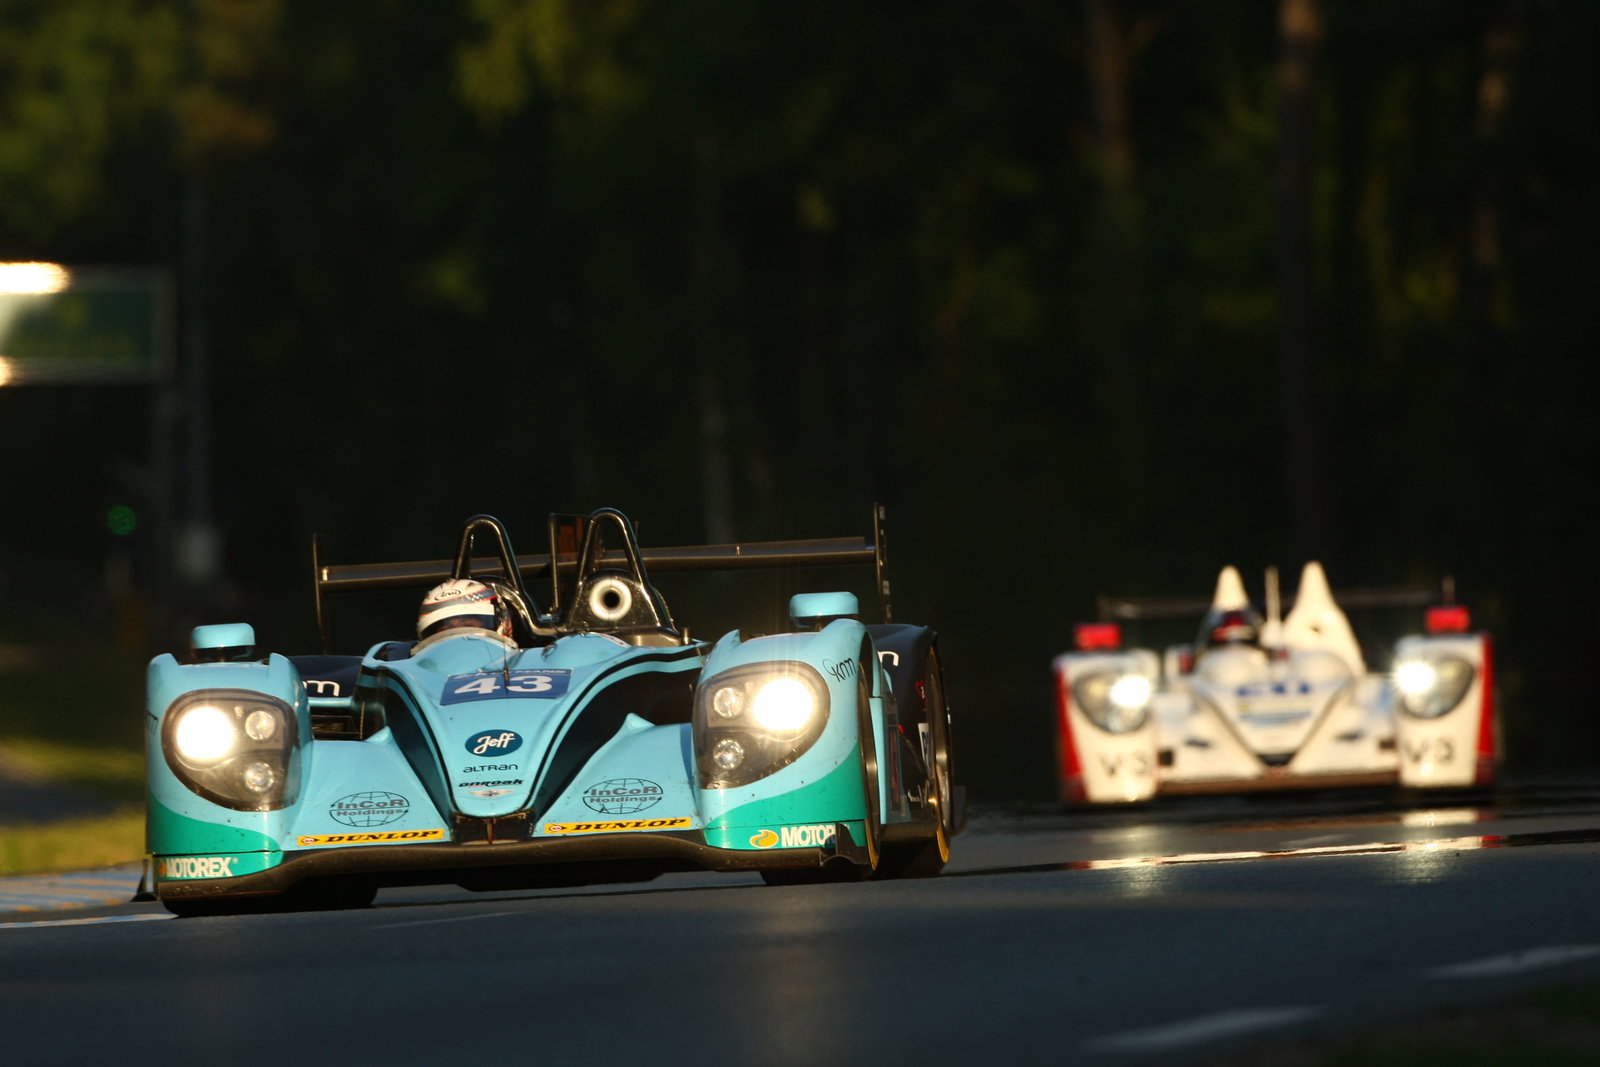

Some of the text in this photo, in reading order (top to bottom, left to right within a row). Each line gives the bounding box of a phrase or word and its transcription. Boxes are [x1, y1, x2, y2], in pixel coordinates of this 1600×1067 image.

[453, 675, 553, 694] 43
[474, 732, 515, 754] Jeff
[590, 785, 659, 796] InCoR
[337, 799, 405, 809] InCoR
[589, 795, 658, 804] Holdings
[336, 808, 403, 817] Holdings
[570, 818, 688, 832] DUNLOP
[324, 830, 439, 843] DUNLOP
[780, 824, 837, 847] MOTOR
[165, 856, 234, 877] MOTOREX
